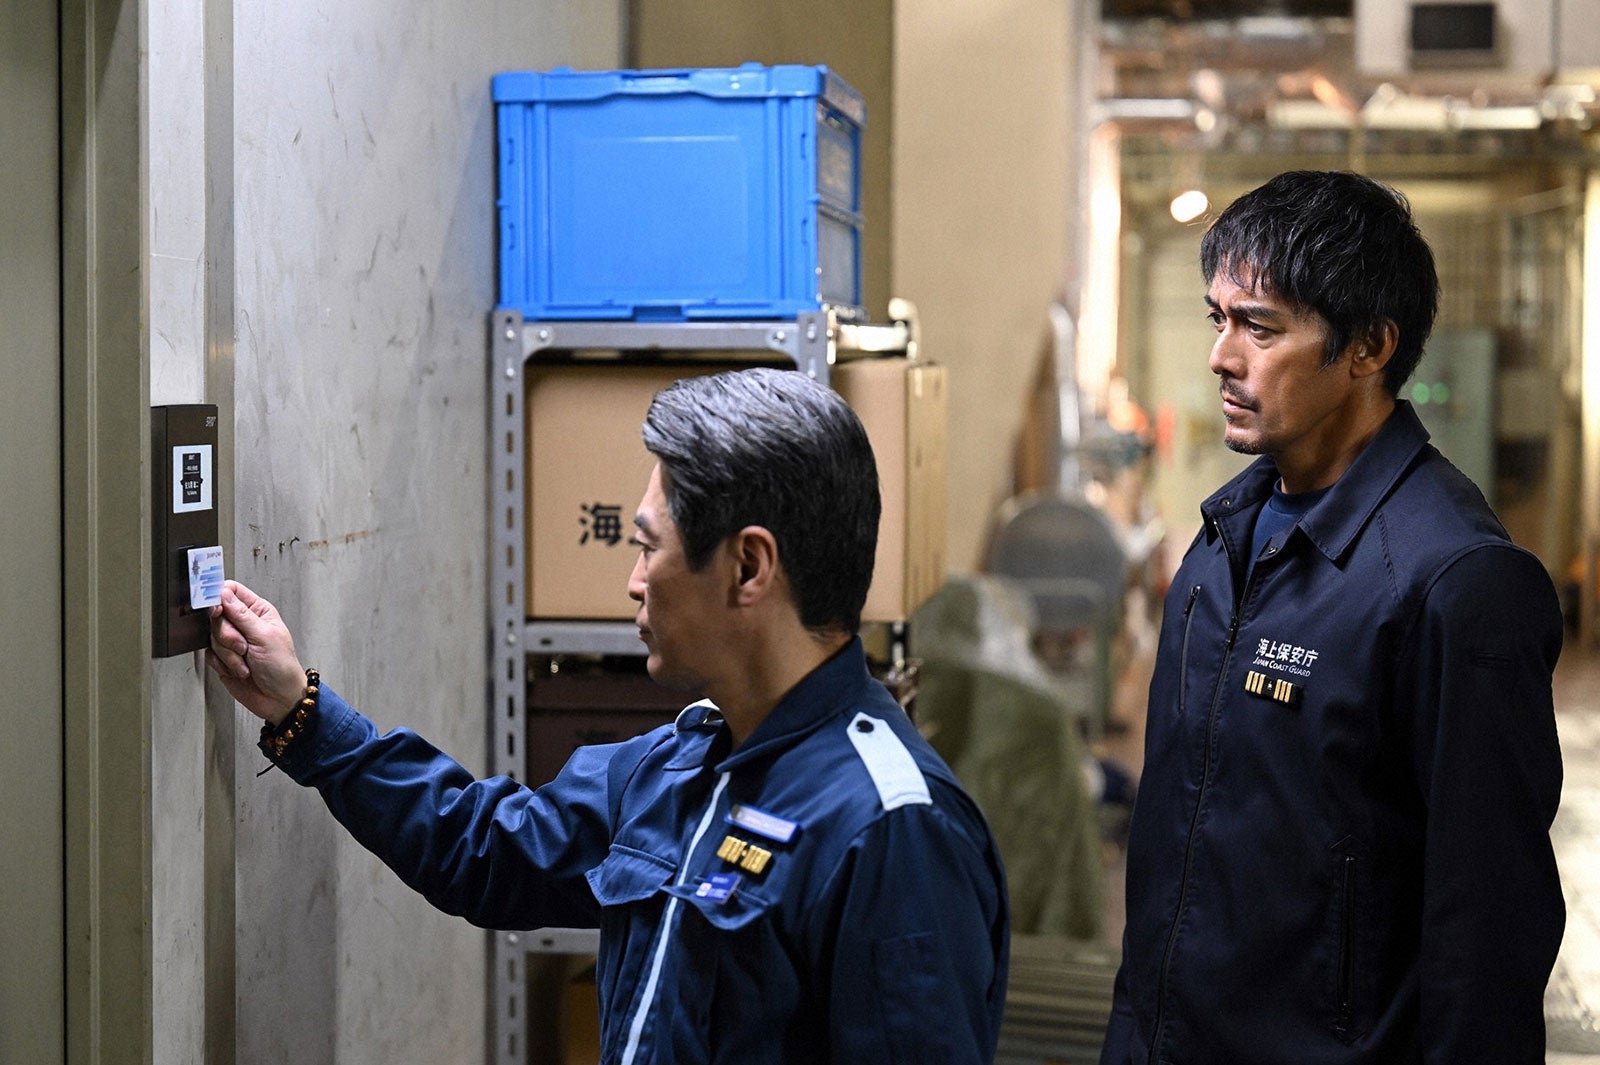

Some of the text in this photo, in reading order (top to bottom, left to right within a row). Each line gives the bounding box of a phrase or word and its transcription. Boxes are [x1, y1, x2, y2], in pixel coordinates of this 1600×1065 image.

[1255, 638, 1319, 668] 海上保安庁
